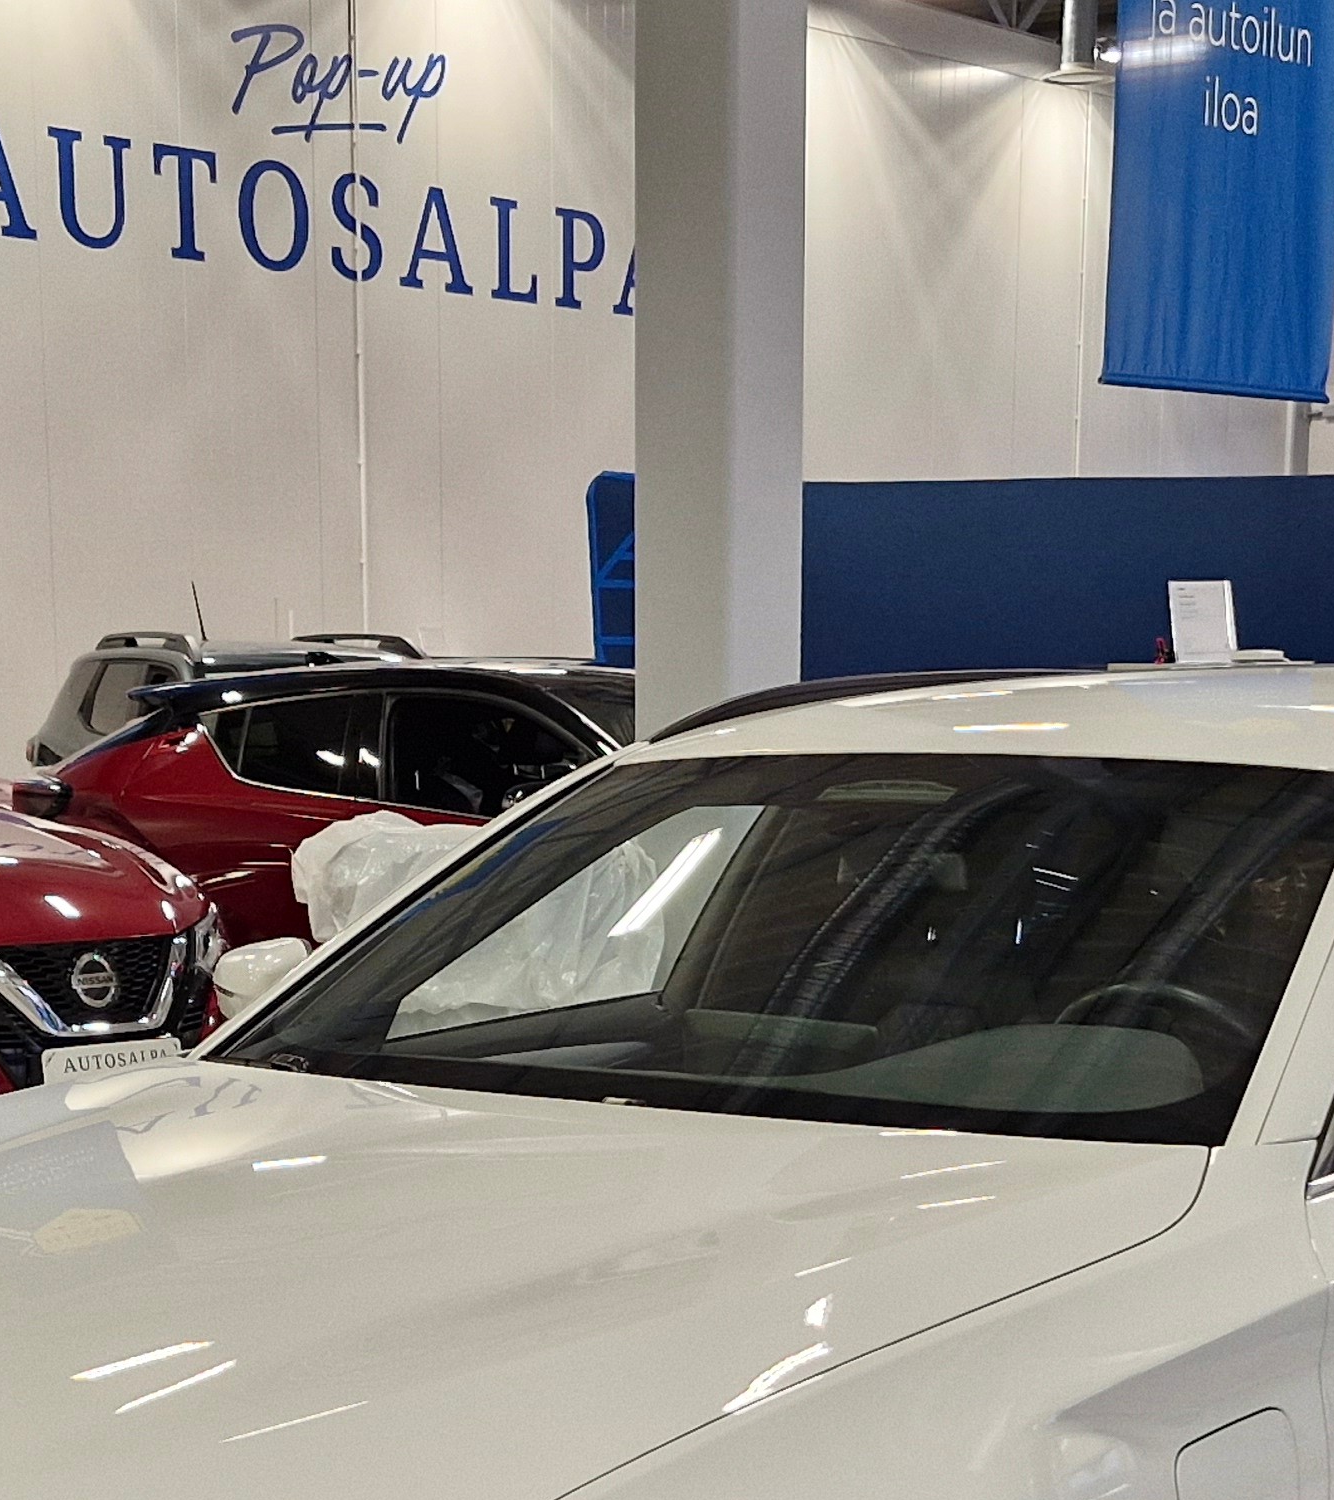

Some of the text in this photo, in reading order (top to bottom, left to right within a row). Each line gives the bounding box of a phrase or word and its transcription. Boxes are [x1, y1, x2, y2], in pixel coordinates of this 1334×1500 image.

[1189, 2, 1313, 67] autoilun
[231, 24, 447, 145] Pop-up
[1203, 75, 1259, 136] iloa
[77, 973, 114, 986] NISSAN
